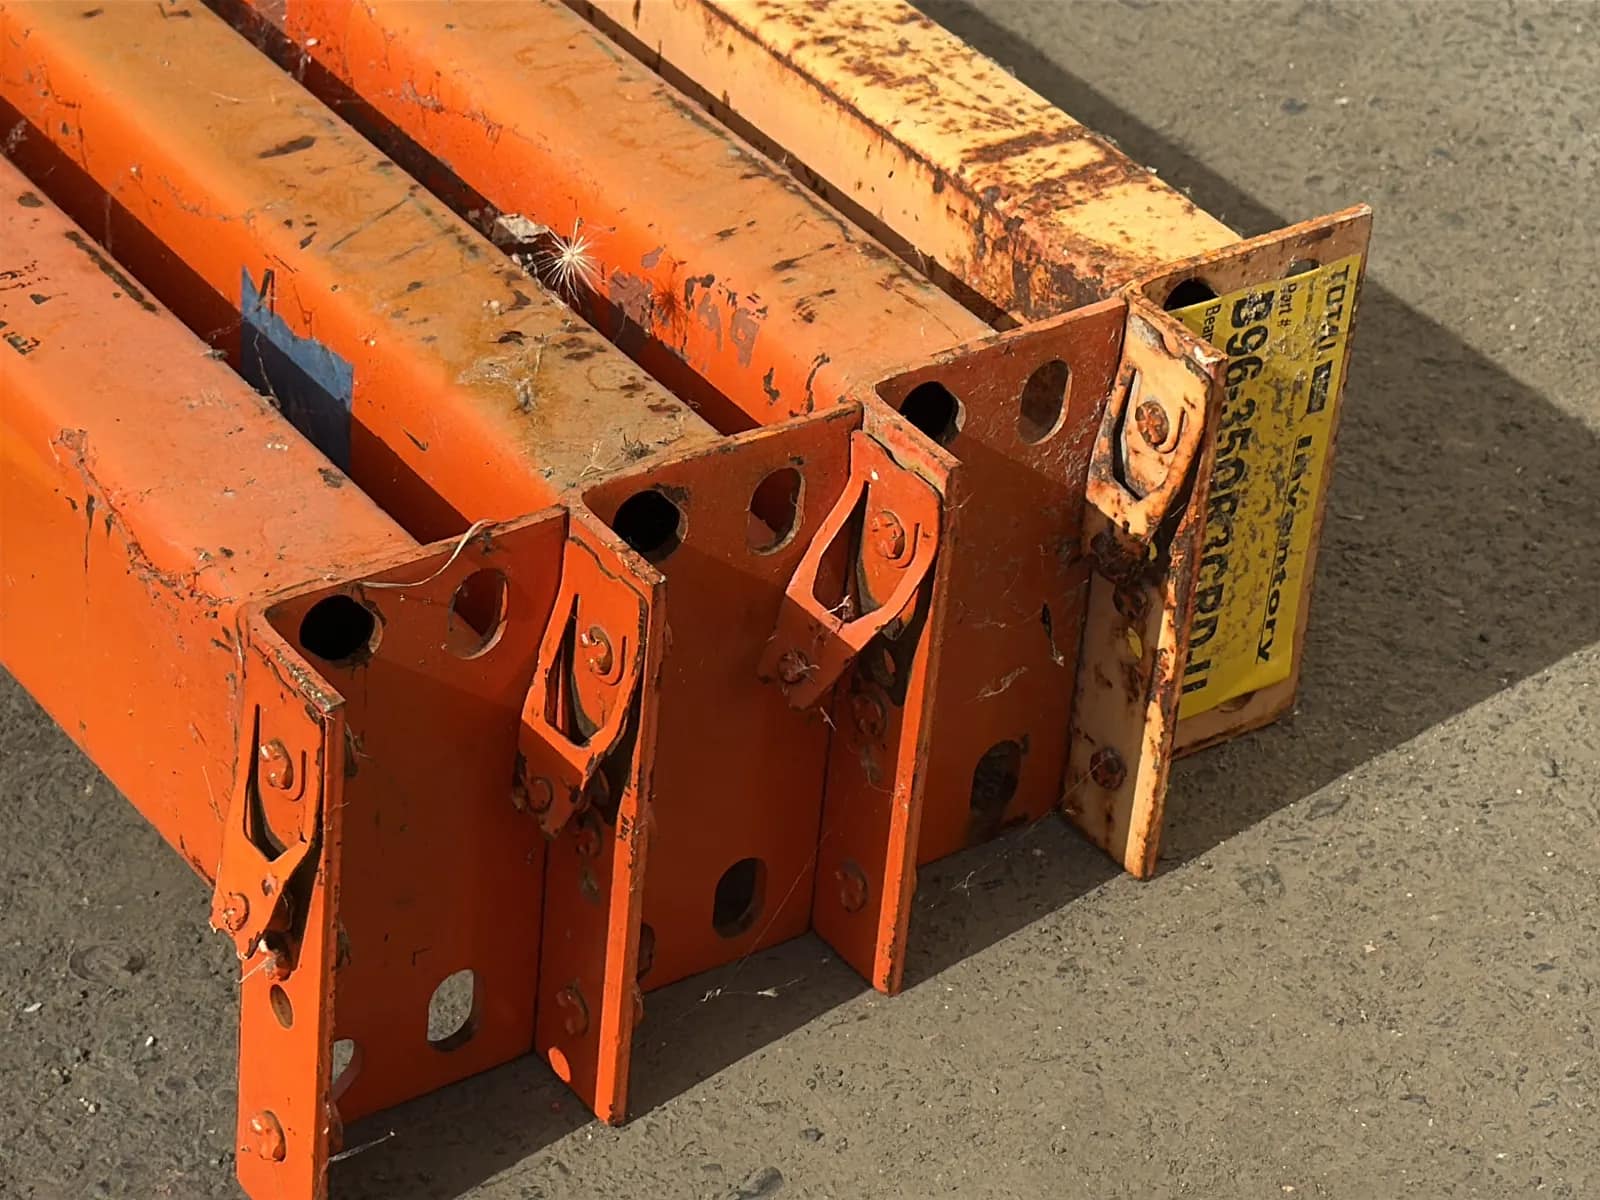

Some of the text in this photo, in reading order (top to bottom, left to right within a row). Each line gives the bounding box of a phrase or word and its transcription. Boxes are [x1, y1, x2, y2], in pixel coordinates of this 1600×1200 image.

[1279, 283, 1297, 315] Part
[1314, 264, 1350, 361] TOTAL
[1257, 435, 1313, 662] Inventory
